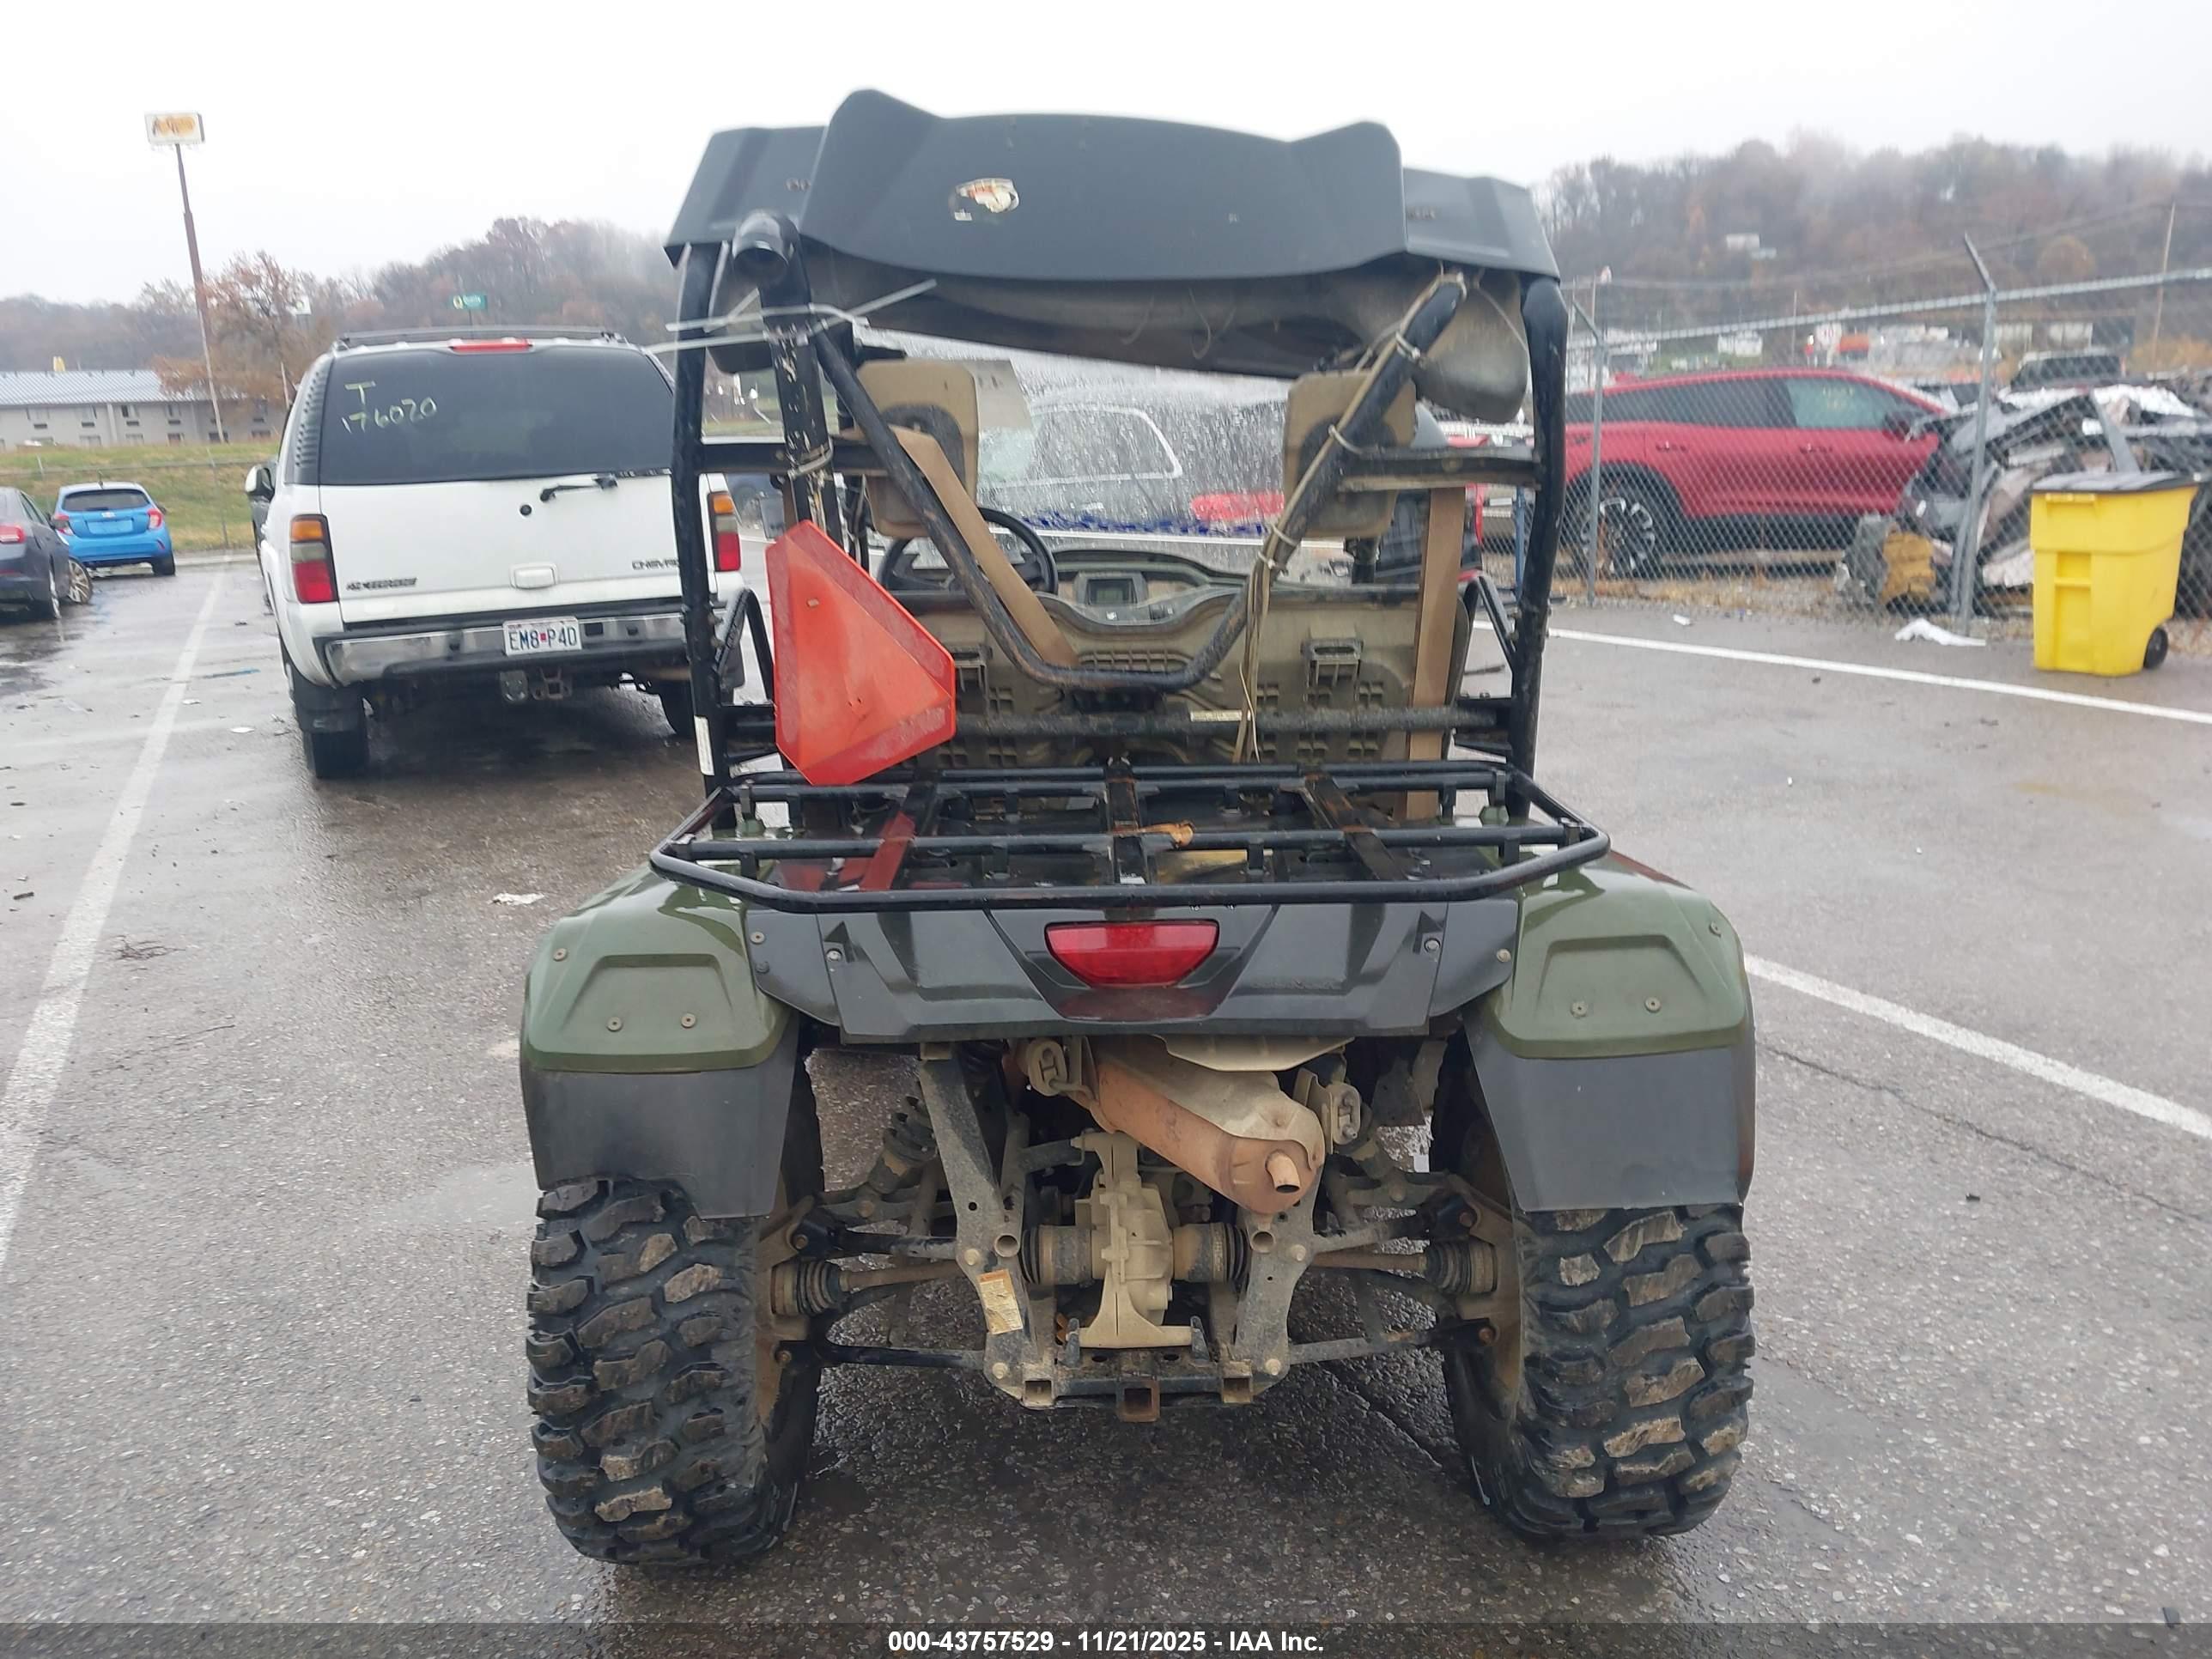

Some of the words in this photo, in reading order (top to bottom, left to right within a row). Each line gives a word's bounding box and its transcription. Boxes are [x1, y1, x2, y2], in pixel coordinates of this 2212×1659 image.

[344, 380, 376, 405] T
[341, 397, 437, 434] 176020
[508, 629, 540, 651] EM8
